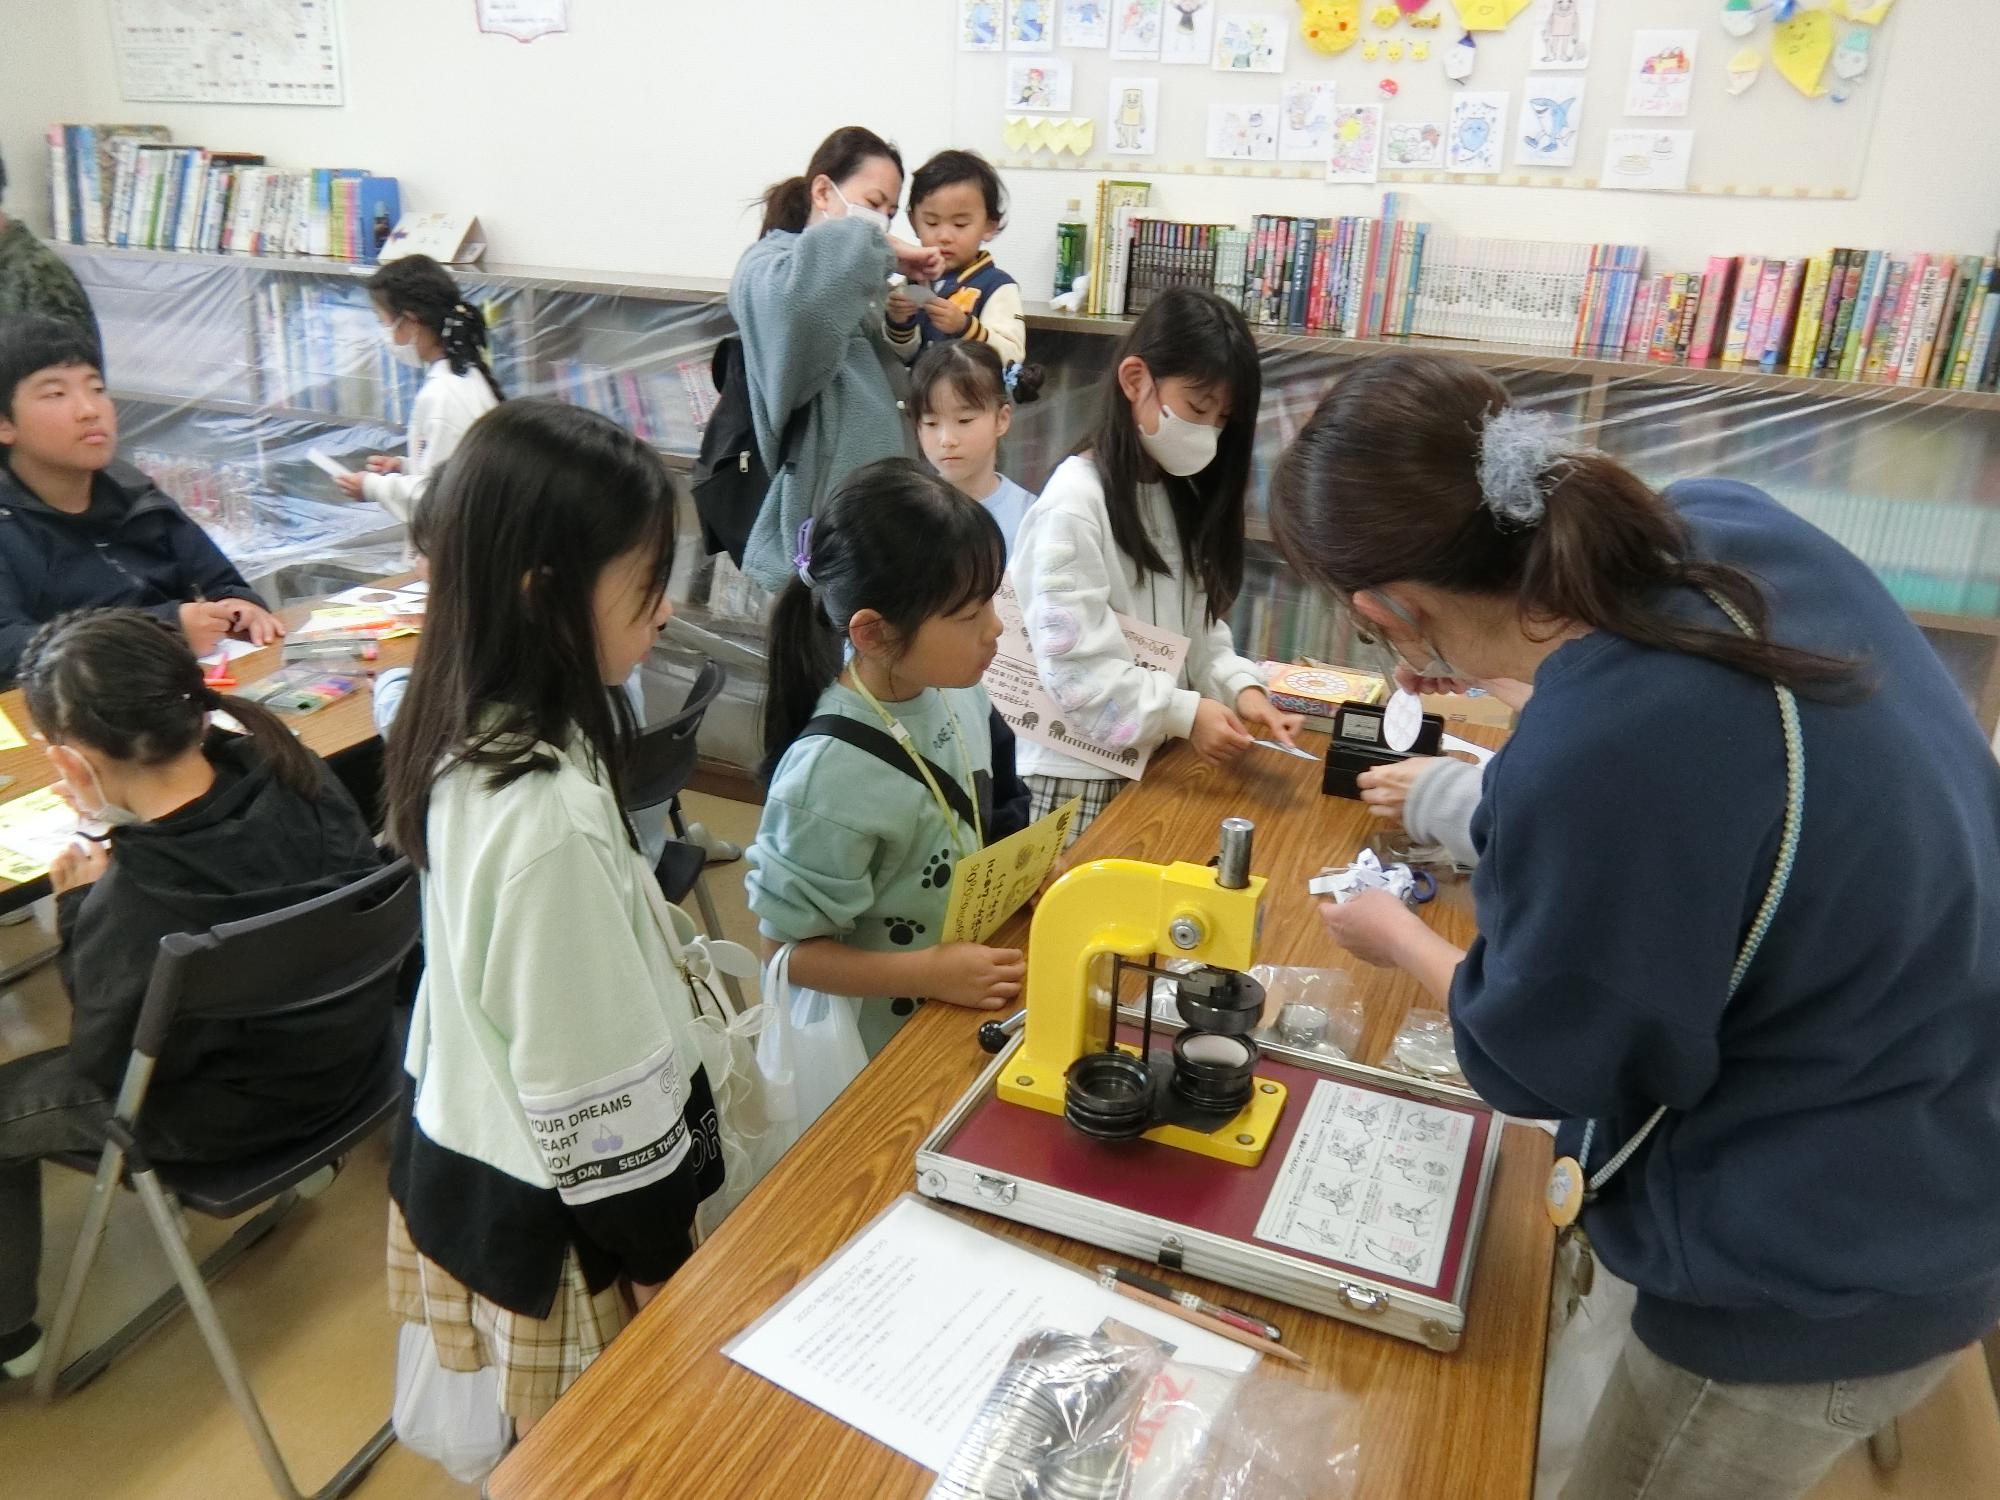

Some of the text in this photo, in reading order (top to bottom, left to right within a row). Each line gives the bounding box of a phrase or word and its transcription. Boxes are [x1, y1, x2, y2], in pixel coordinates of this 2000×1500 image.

[531, 1094, 632, 1133] OUR DREAMS
[537, 1132, 579, 1151] EART
[577, 1164, 602, 1180] DAY
[618, 1147, 657, 1170] SEIZE
[656, 1131, 677, 1153] THE
